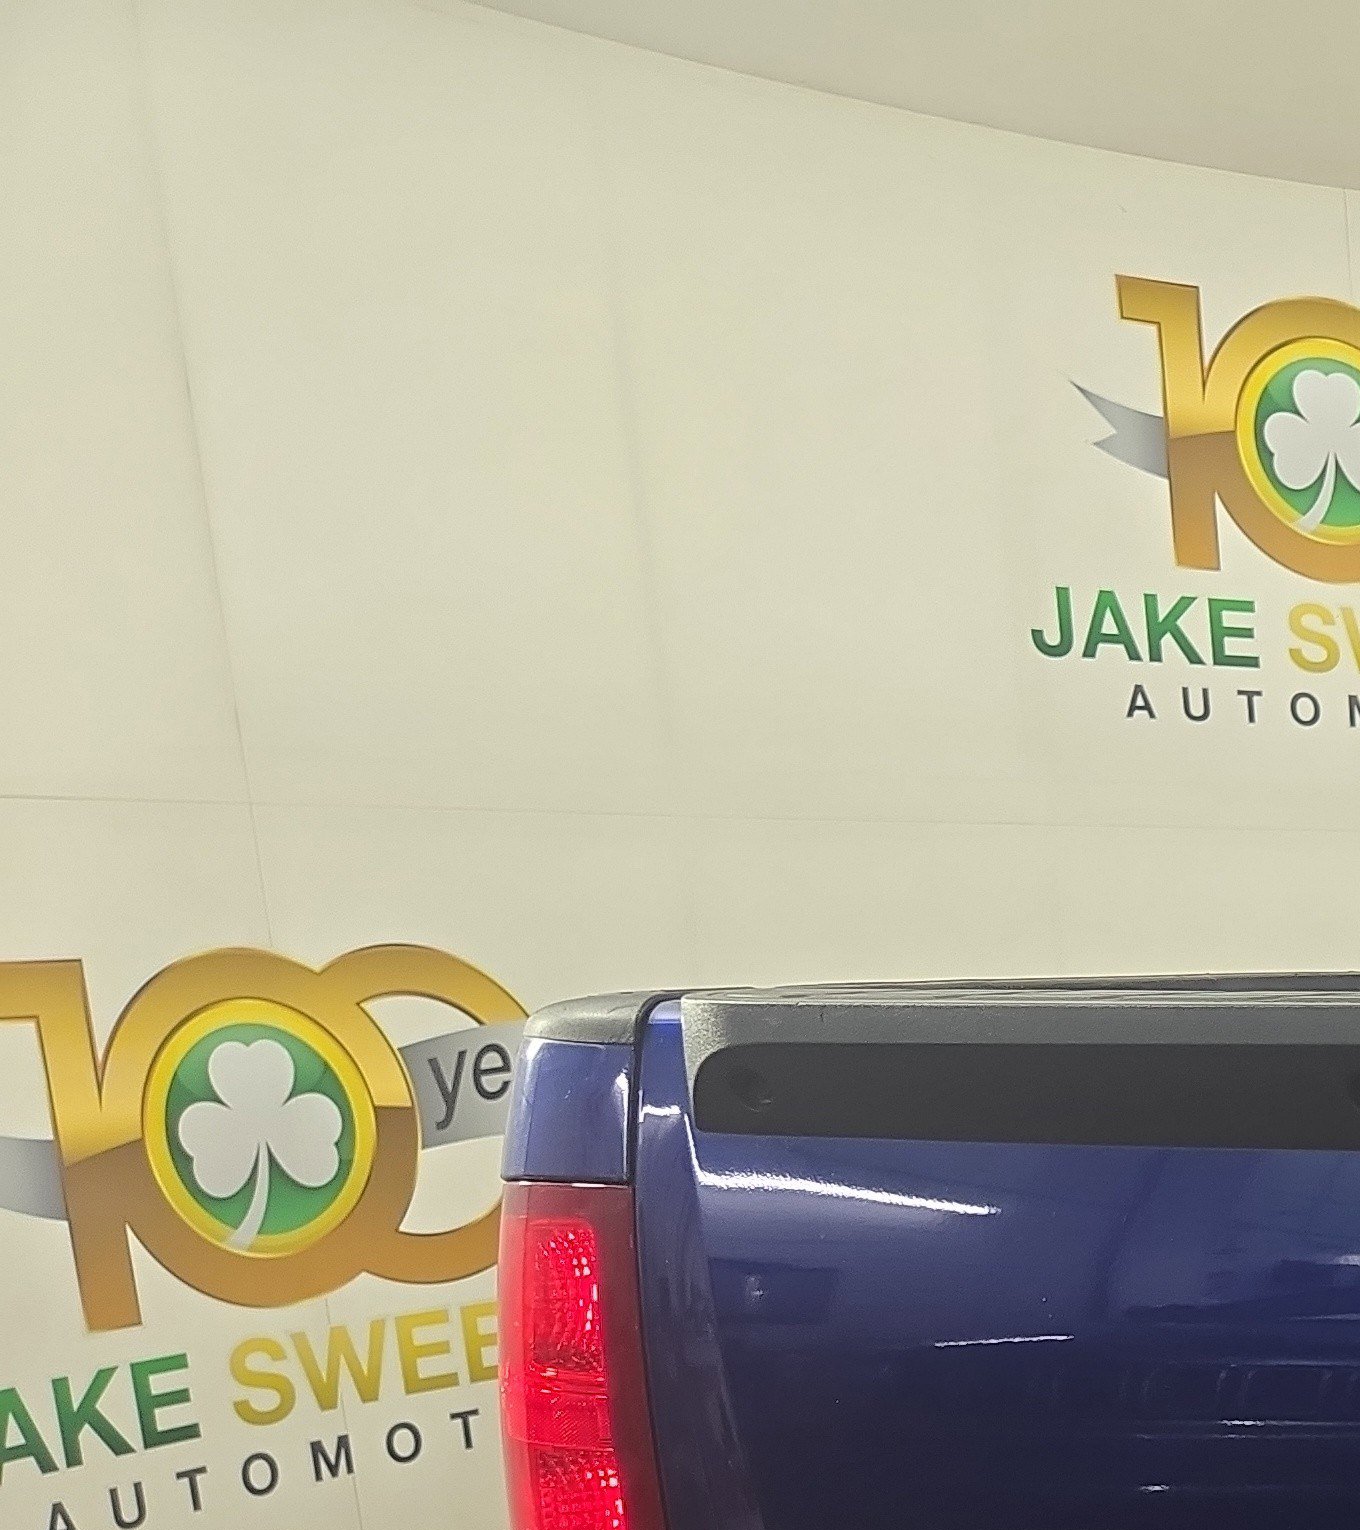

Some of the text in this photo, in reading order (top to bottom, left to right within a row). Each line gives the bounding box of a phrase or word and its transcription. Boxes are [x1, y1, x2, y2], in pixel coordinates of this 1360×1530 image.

[1030, 586, 1261, 669] JAKE
[0, 1301, 500, 1486] AKE SWEE
